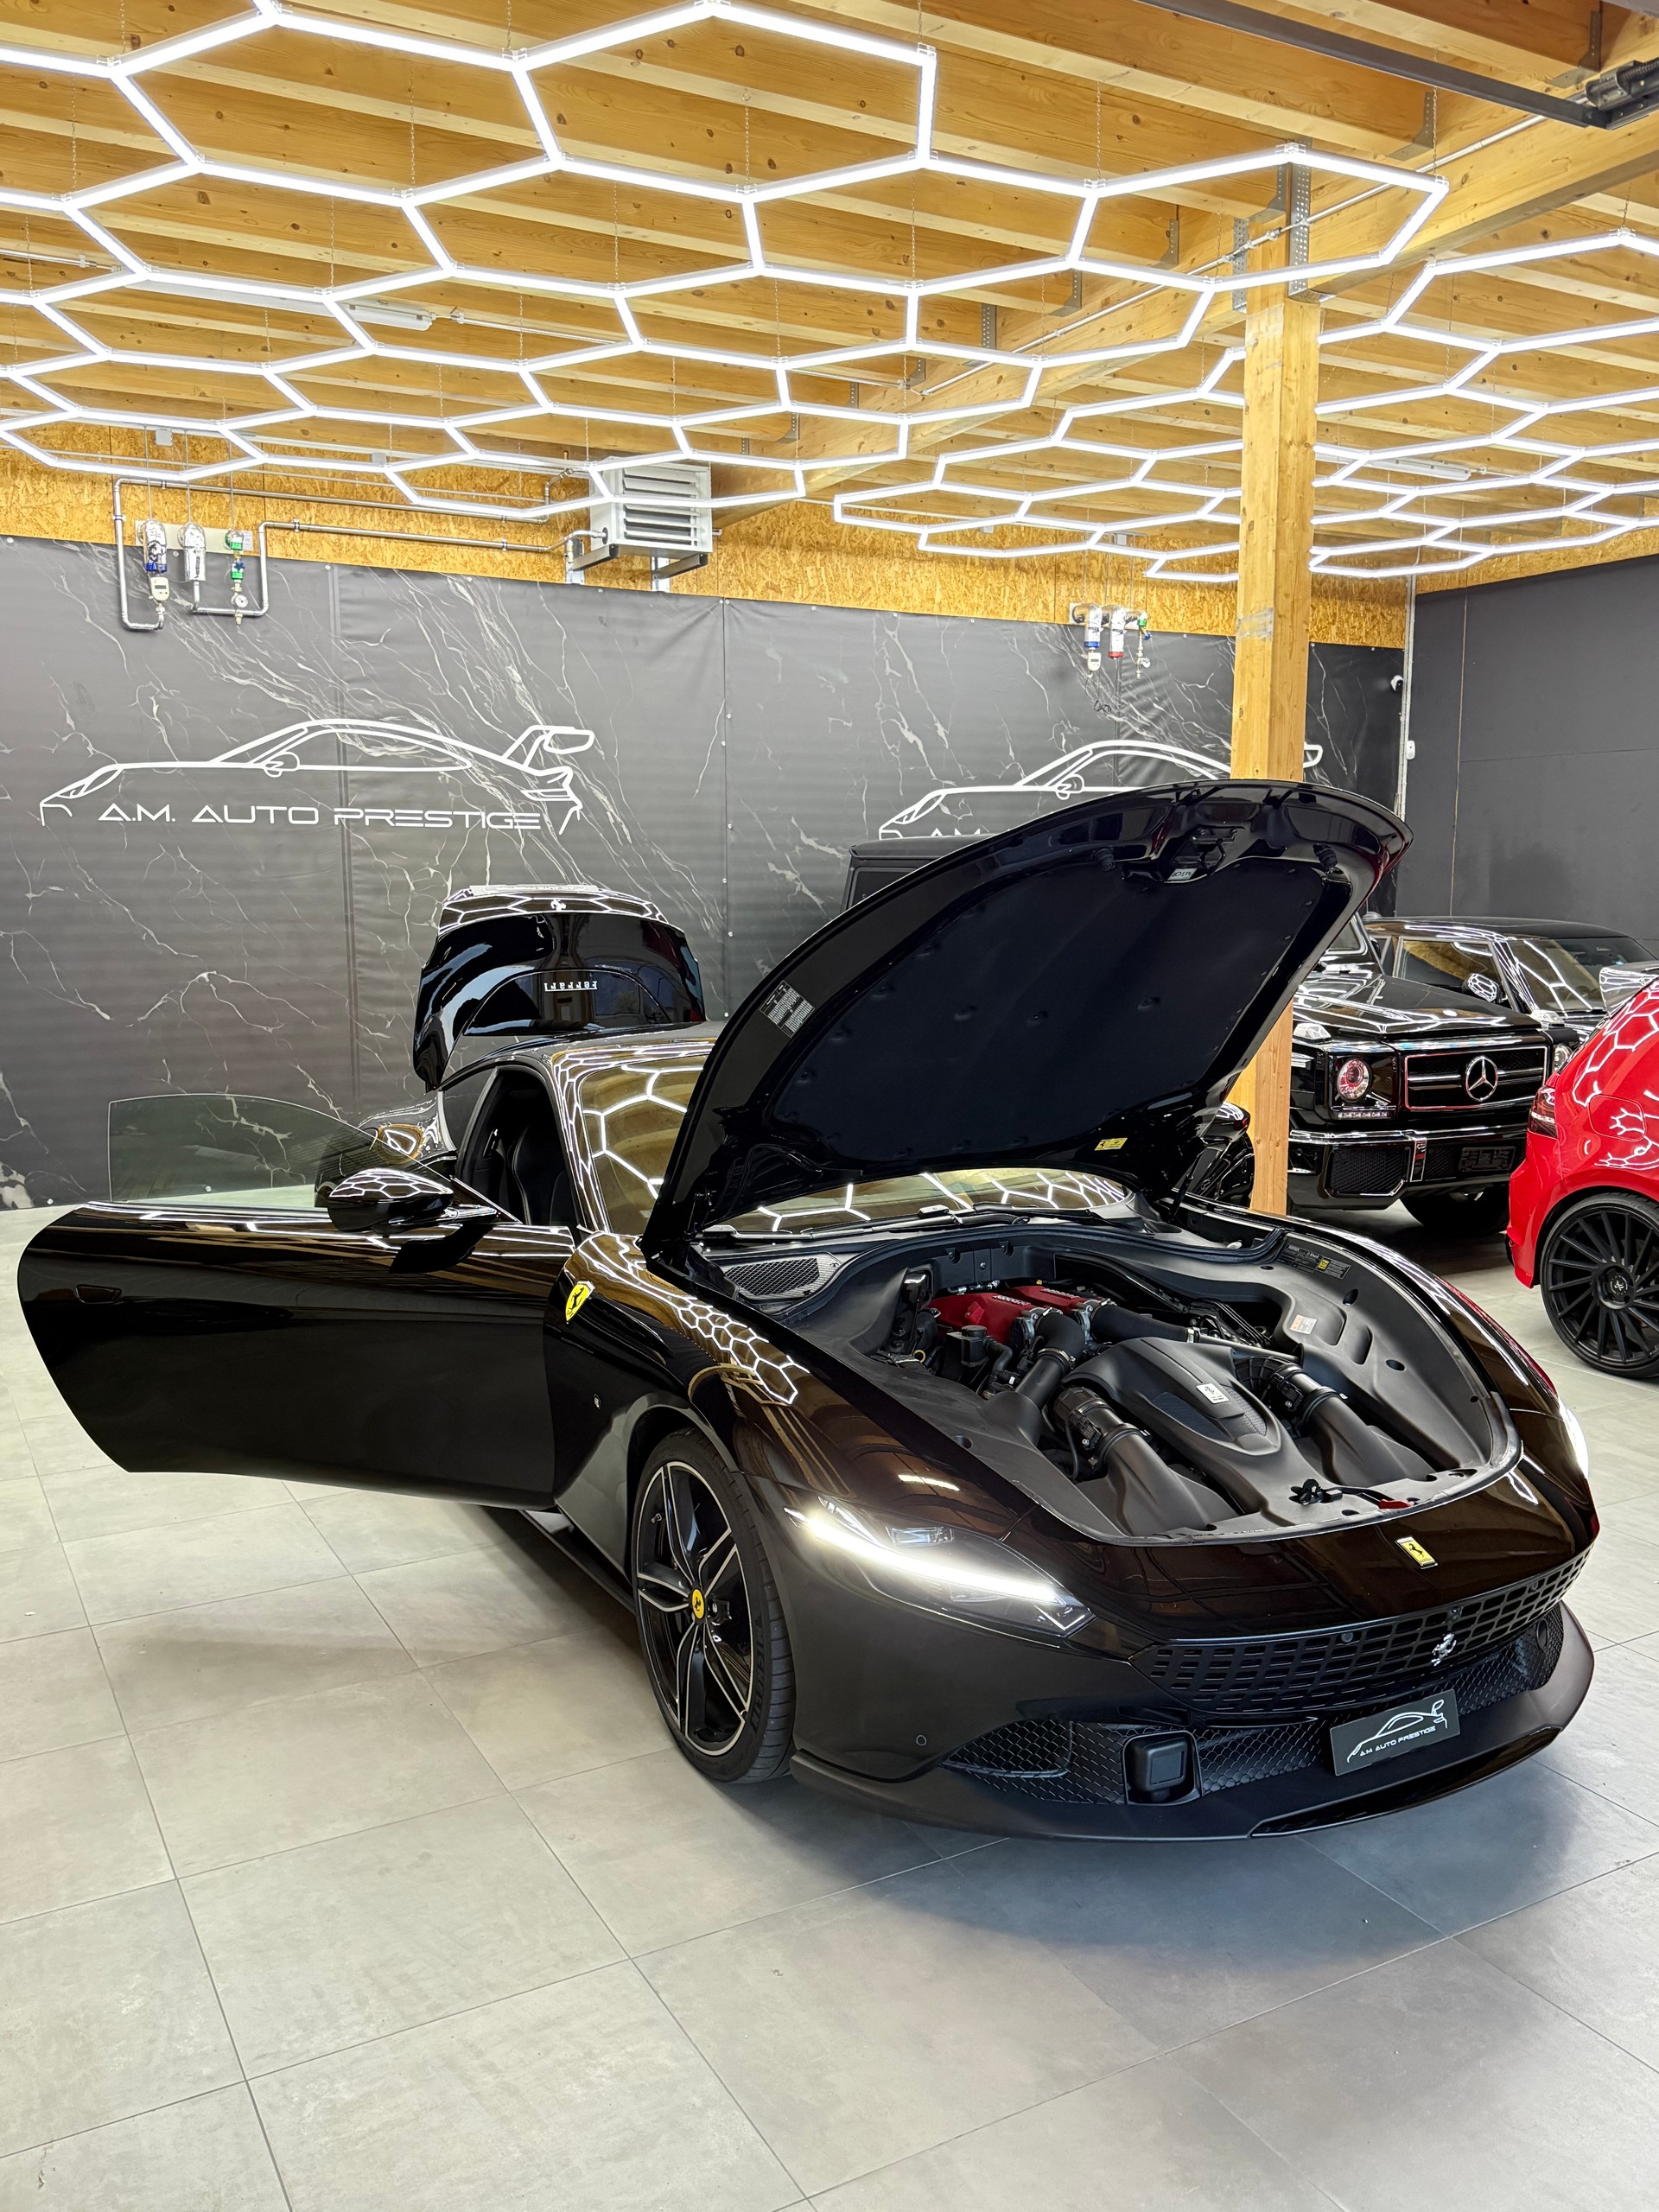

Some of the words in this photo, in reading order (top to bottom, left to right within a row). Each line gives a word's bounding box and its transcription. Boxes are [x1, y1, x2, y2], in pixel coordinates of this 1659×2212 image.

[98, 803, 176, 822] A.M.
[191, 804, 319, 824] AUTO
[334, 807, 541, 830] PRESTIGE
[543, 980, 598, 992] Ferrari
[752, 1624, 765, 1730] MICHELIN
[1376, 1739, 1396, 1751] AUTO
[1398, 1726, 1436, 1743] PRESTIGE
